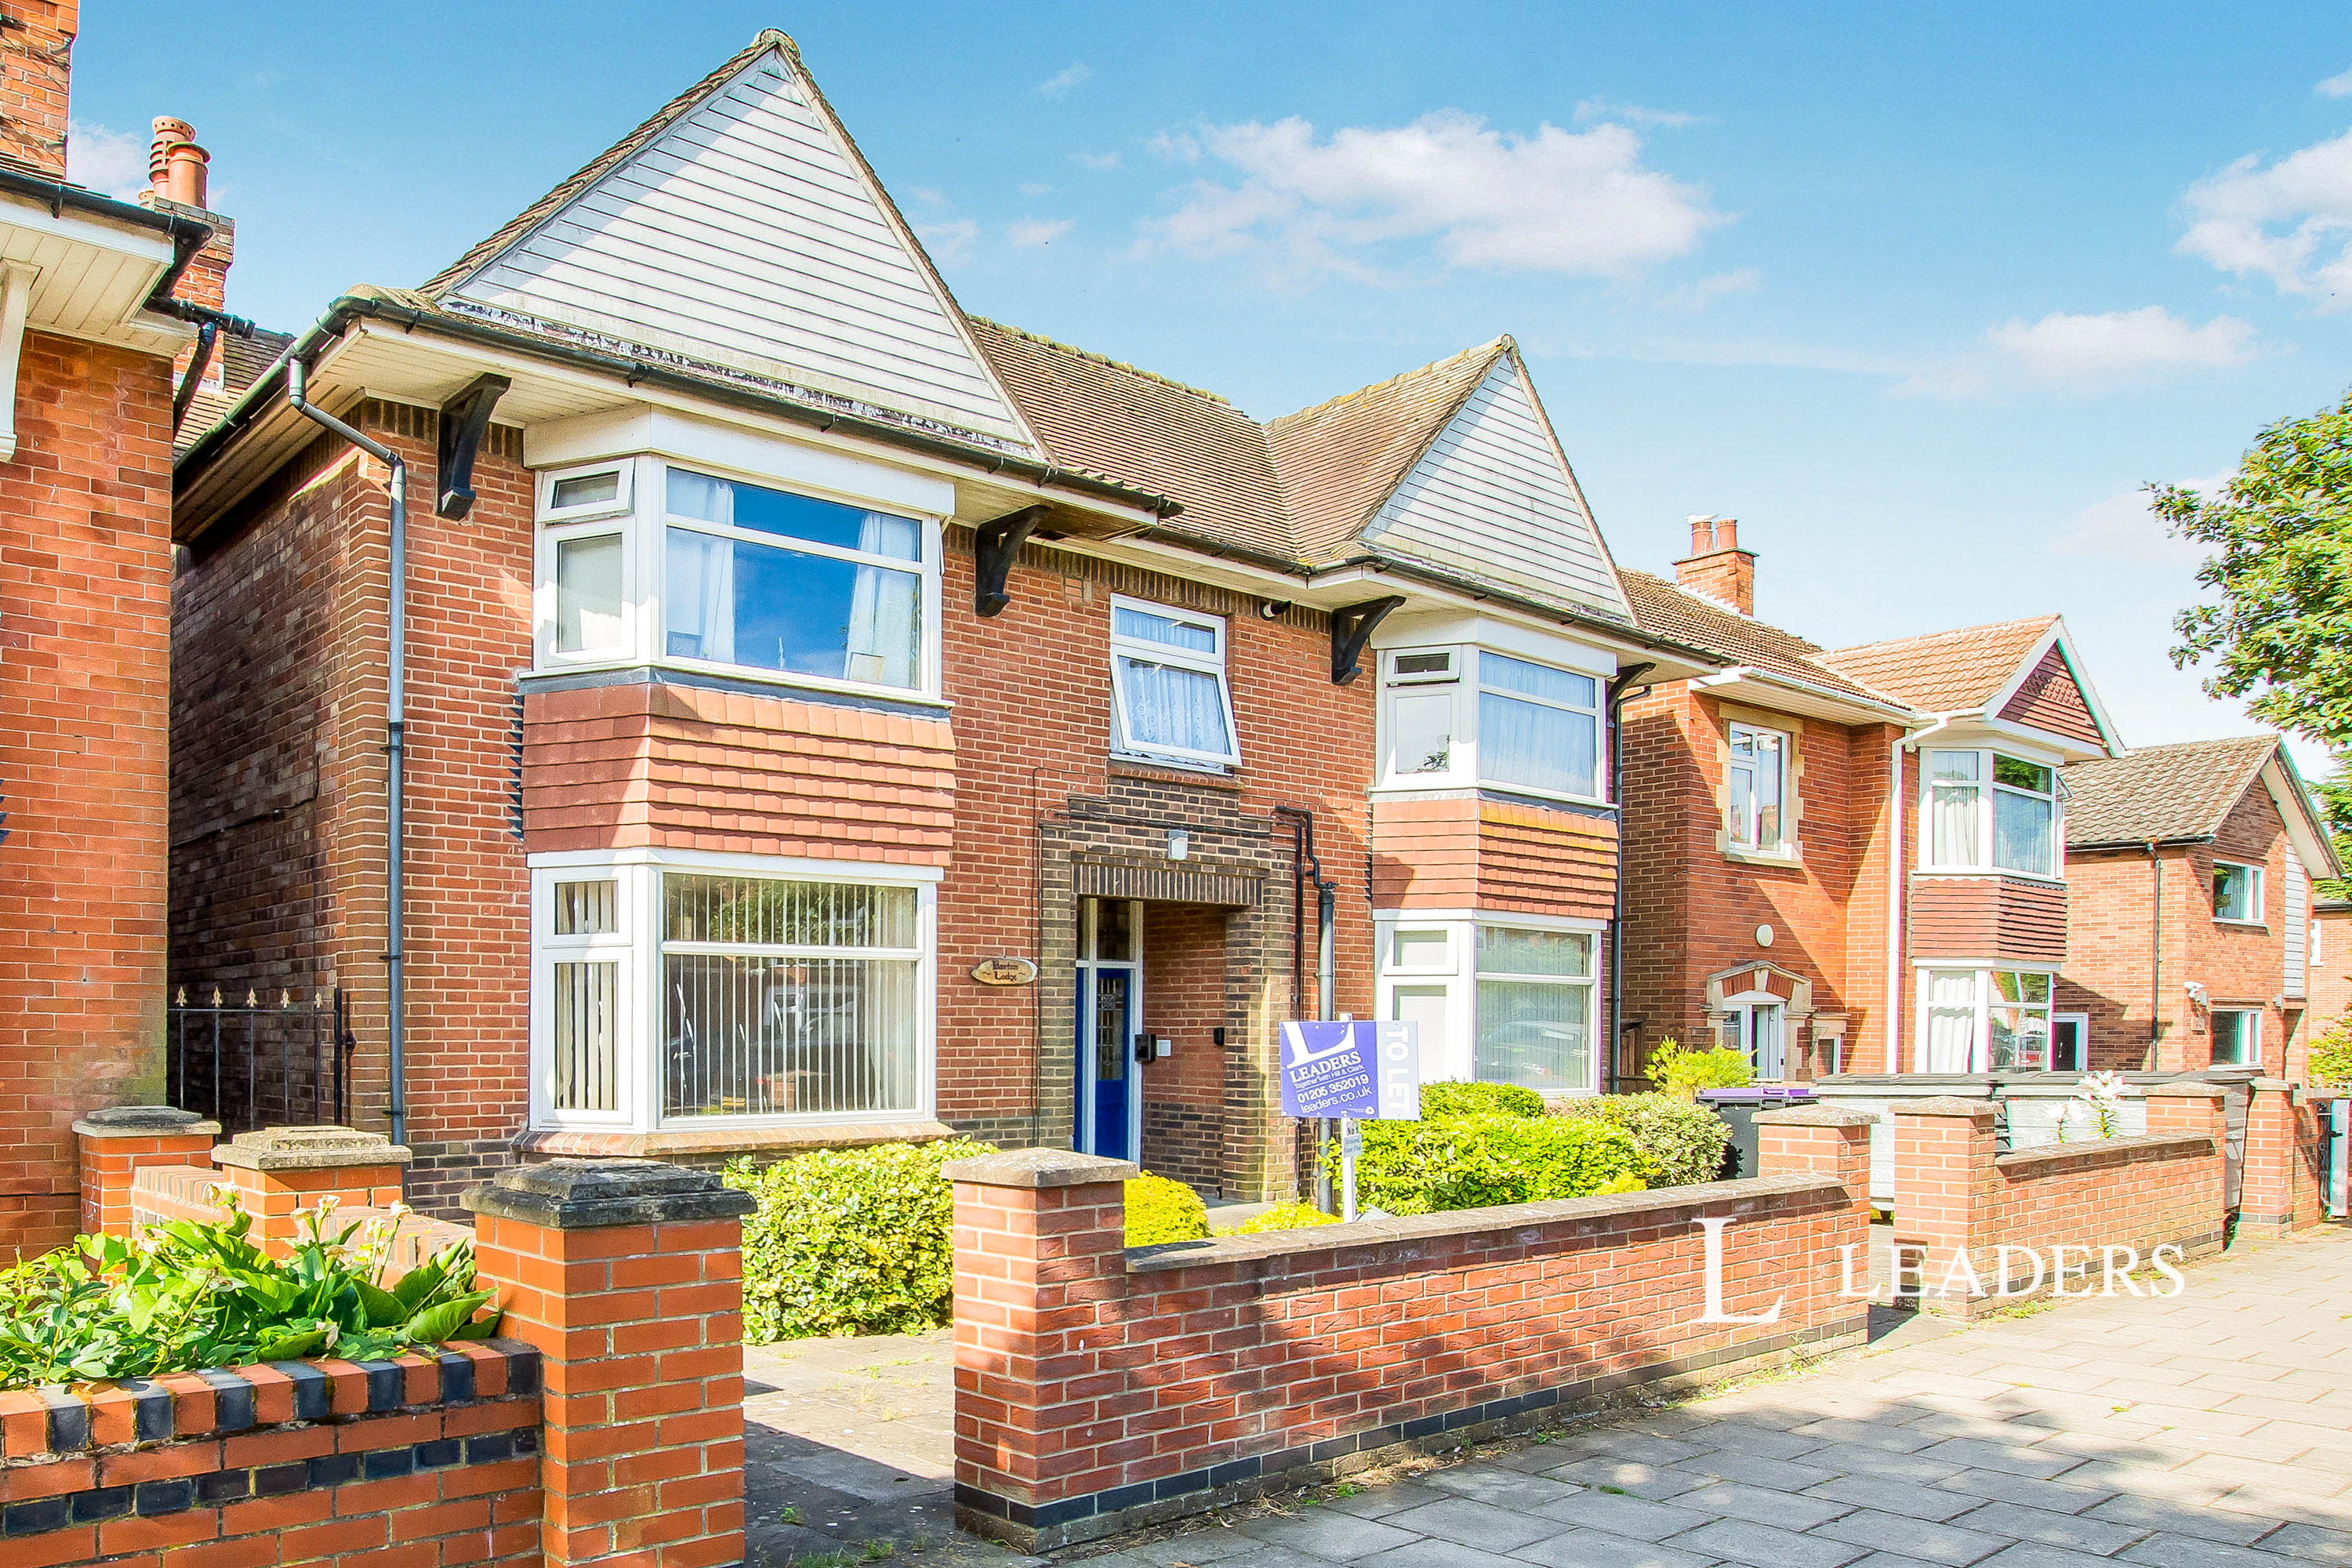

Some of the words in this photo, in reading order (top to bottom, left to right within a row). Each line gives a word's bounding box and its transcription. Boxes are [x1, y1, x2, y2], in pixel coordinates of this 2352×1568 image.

[993, 971, 1017, 982] Lodge
[1386, 1025, 1408, 1061] TO
[1289, 1051, 1362, 1083] LEADERS
[1298, 1086, 1329, 1103] 01205
[1328, 1073, 1370, 1094] 352019
[1301, 1085, 1374, 1114] leaders.co.uk
[1386, 1068, 1410, 1113] LET
